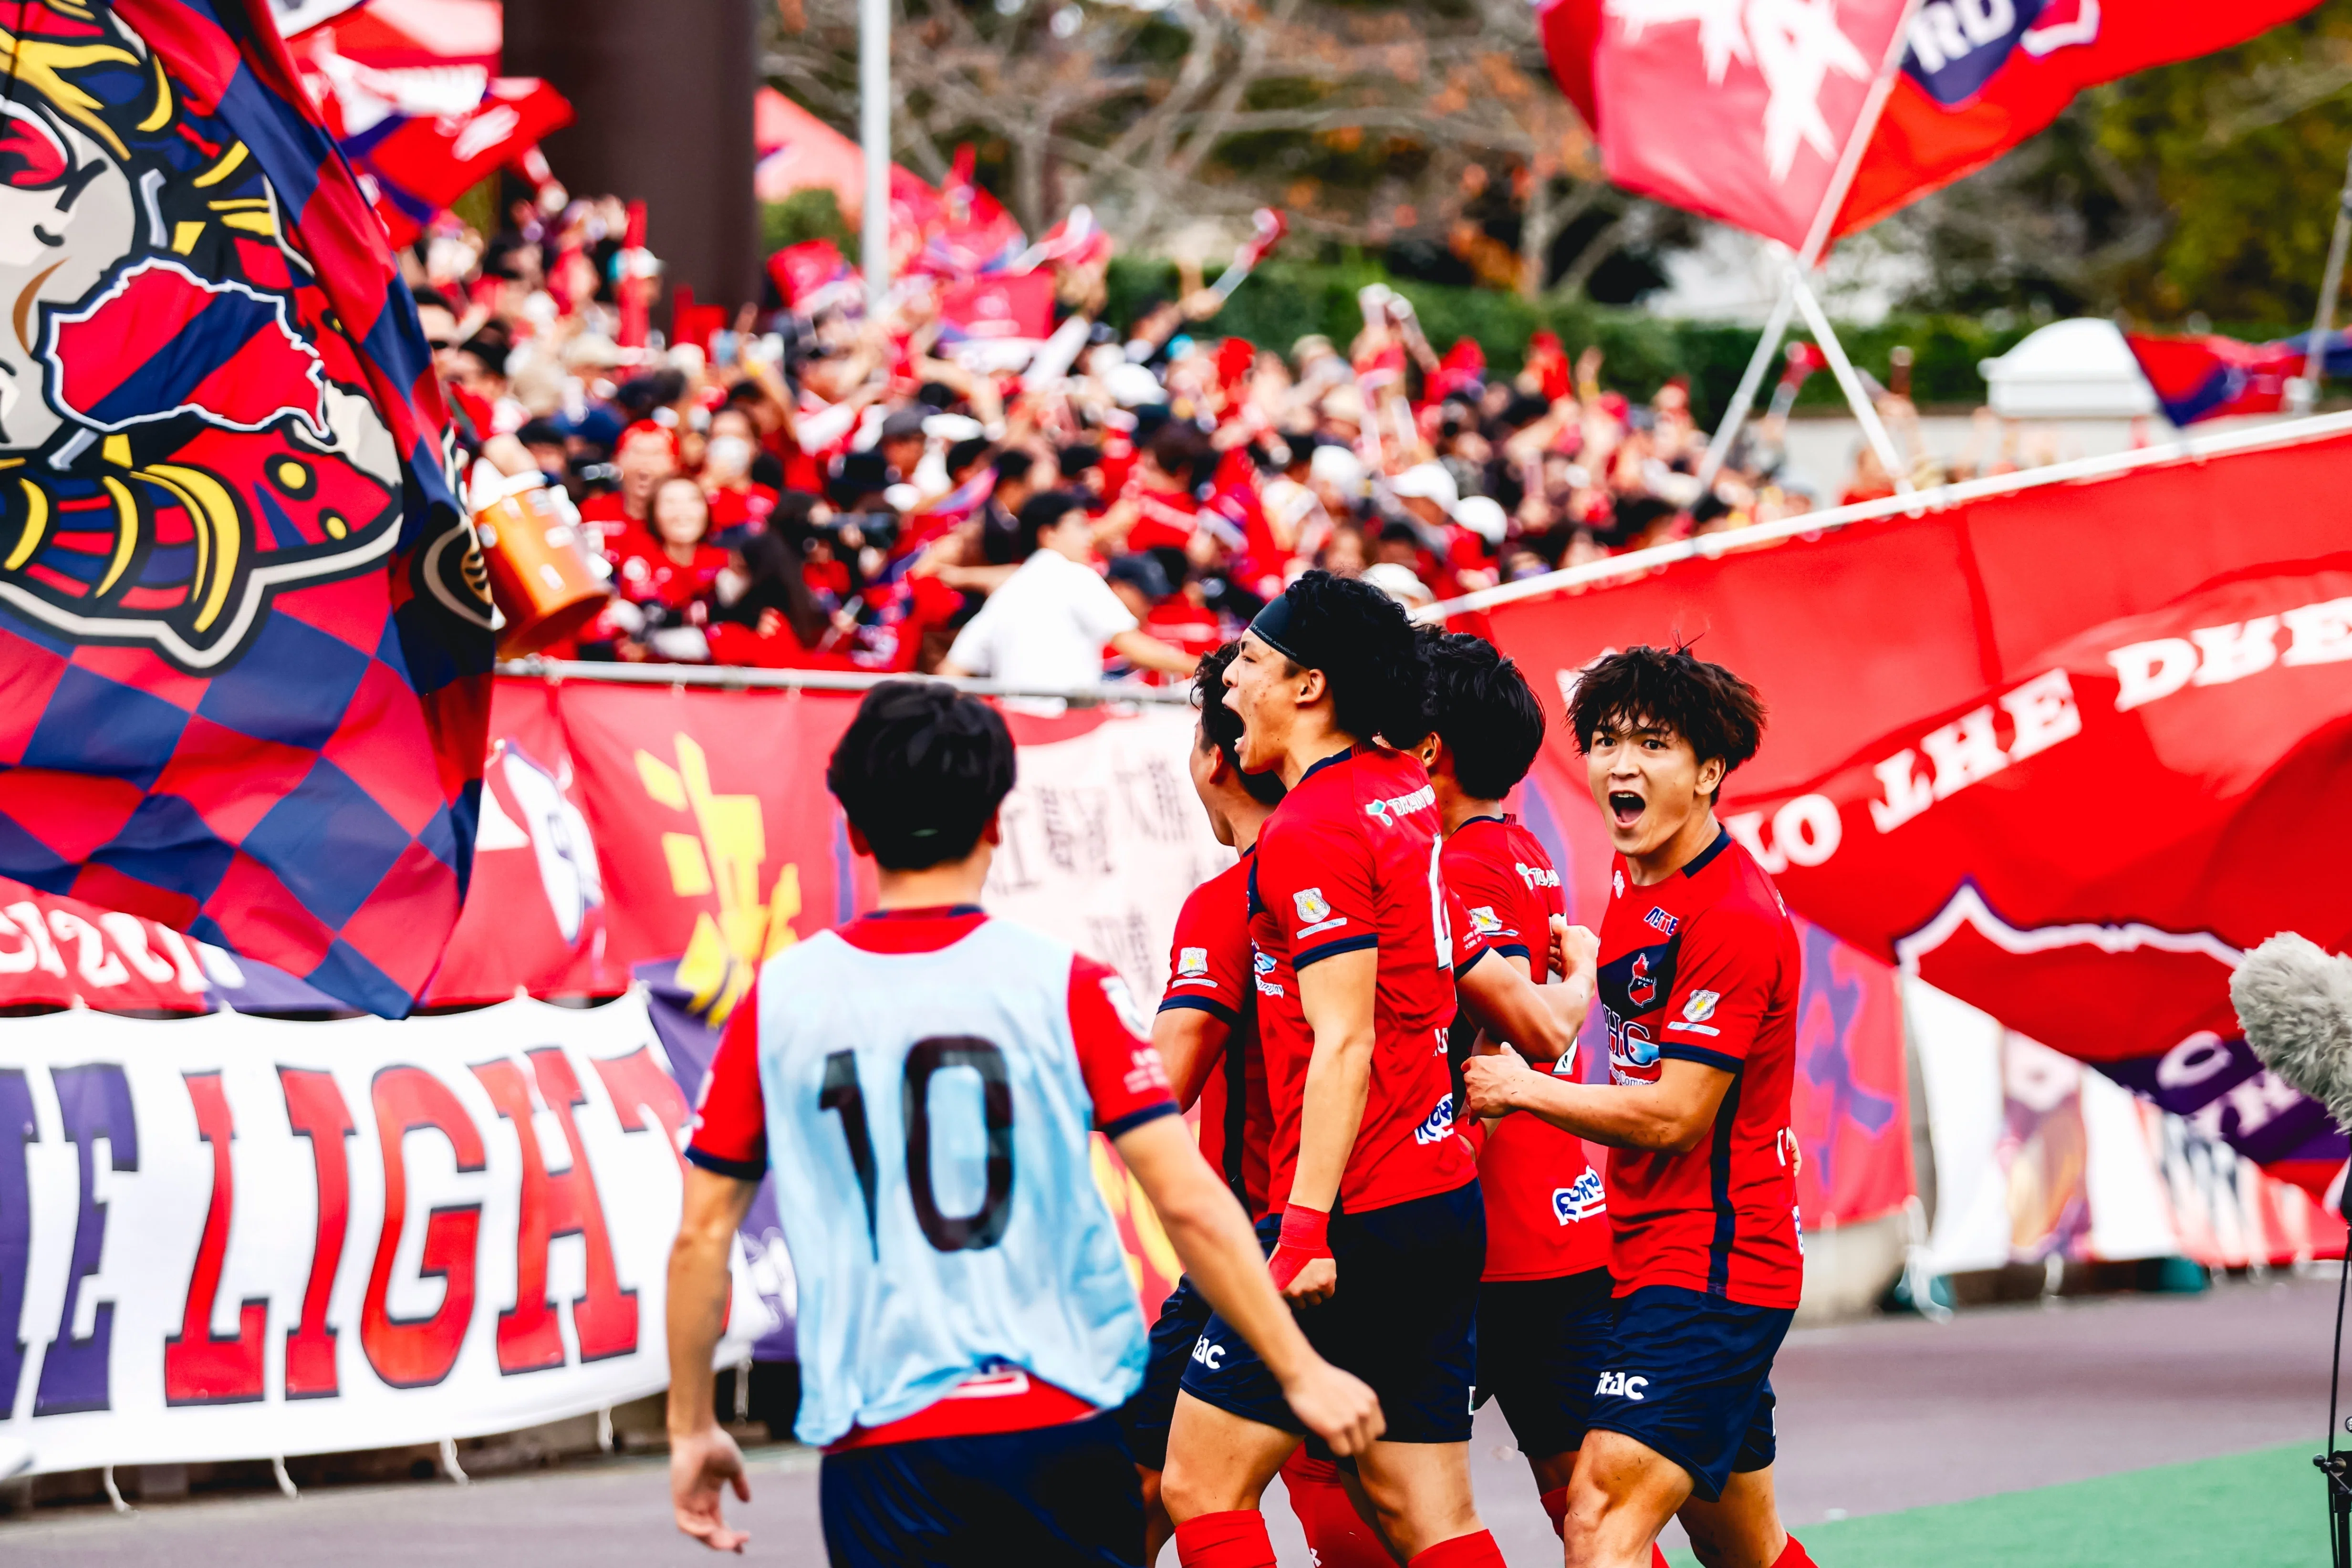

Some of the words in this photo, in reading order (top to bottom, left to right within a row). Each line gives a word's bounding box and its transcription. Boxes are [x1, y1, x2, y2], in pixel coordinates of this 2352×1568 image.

[1257, 628, 1273, 642] UNDER
[1272, 641, 1297, 657] ARMOUR
[1636, 974, 1653, 983] IWAKI
[817, 1033, 1019, 1263] 10
